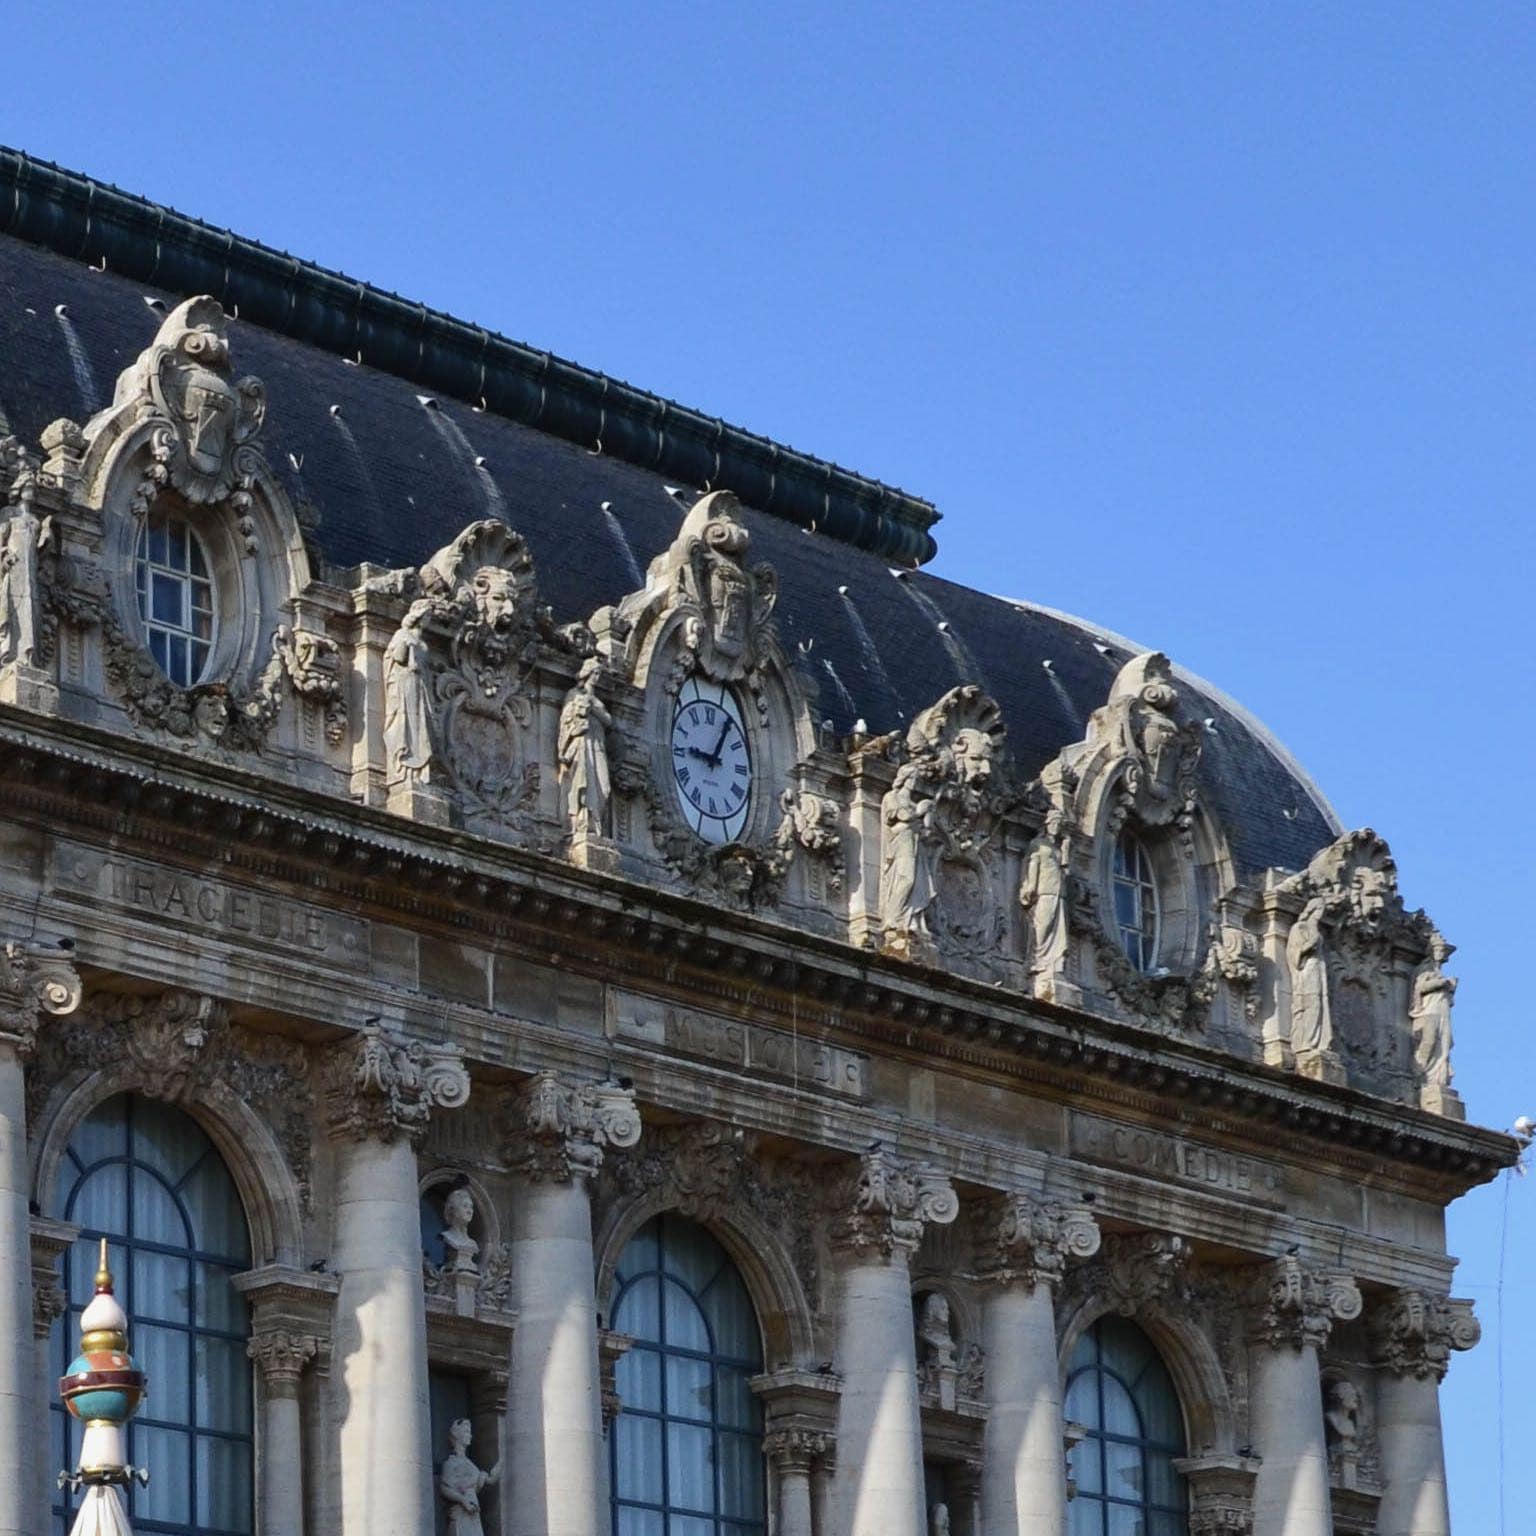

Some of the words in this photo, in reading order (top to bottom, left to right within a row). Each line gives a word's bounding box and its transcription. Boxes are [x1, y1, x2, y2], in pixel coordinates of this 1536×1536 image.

[677, 723, 688, 738] X
[735, 765, 747, 776] III
[724, 798, 733, 813] V
[103, 860, 326, 952] TRAGEDIE
[1114, 1127, 1251, 1191] COMEDIE
